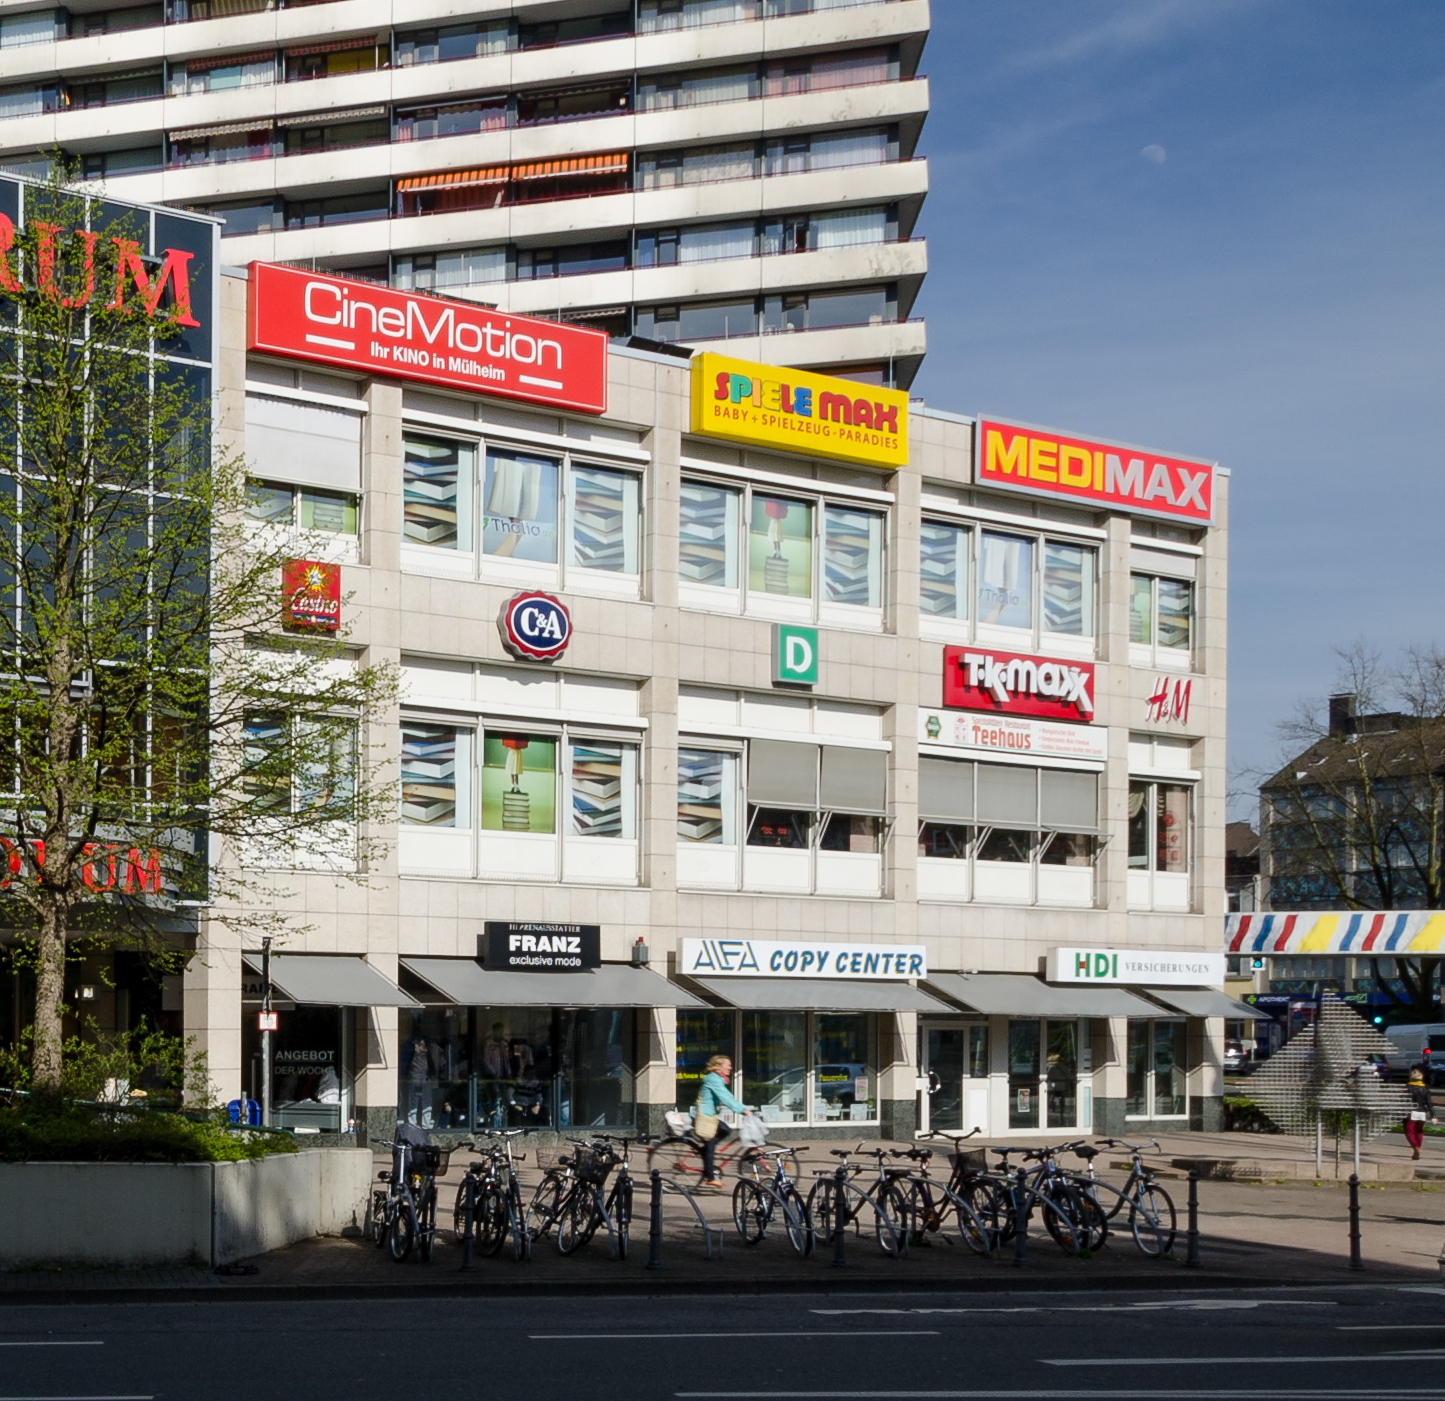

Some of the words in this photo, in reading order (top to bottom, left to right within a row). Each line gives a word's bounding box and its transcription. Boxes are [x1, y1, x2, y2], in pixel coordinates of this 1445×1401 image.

[304, 281, 563, 370] CineMotion
[370, 340, 390, 359] Ihr
[392, 345, 429, 367] KINO
[432, 352, 445, 369] in
[448, 356, 506, 382] Mülheim
[714, 371, 813, 417] SPIELE
[714, 405, 749, 422] BABY
[986, 429, 1209, 512] MEDIMAX
[520, 607, 563, 639] C&A
[1145, 675, 1192, 727] H&M
[972, 725, 1031, 749] Teehaus
[509, 934, 582, 954] FRANZ
[509, 955, 553, 966] exclusive
[770, 949, 830, 973] COPY
[835, 952, 924, 977] CENTER
[1074, 952, 1118, 978] HDI
[1125, 961, 1210, 974] VERSICHERUNGEN
[275, 1050, 335, 1061] ANGEBOT
[274, 1066, 295, 1075] DER
[297, 1066, 335, 1075] WOCHE
